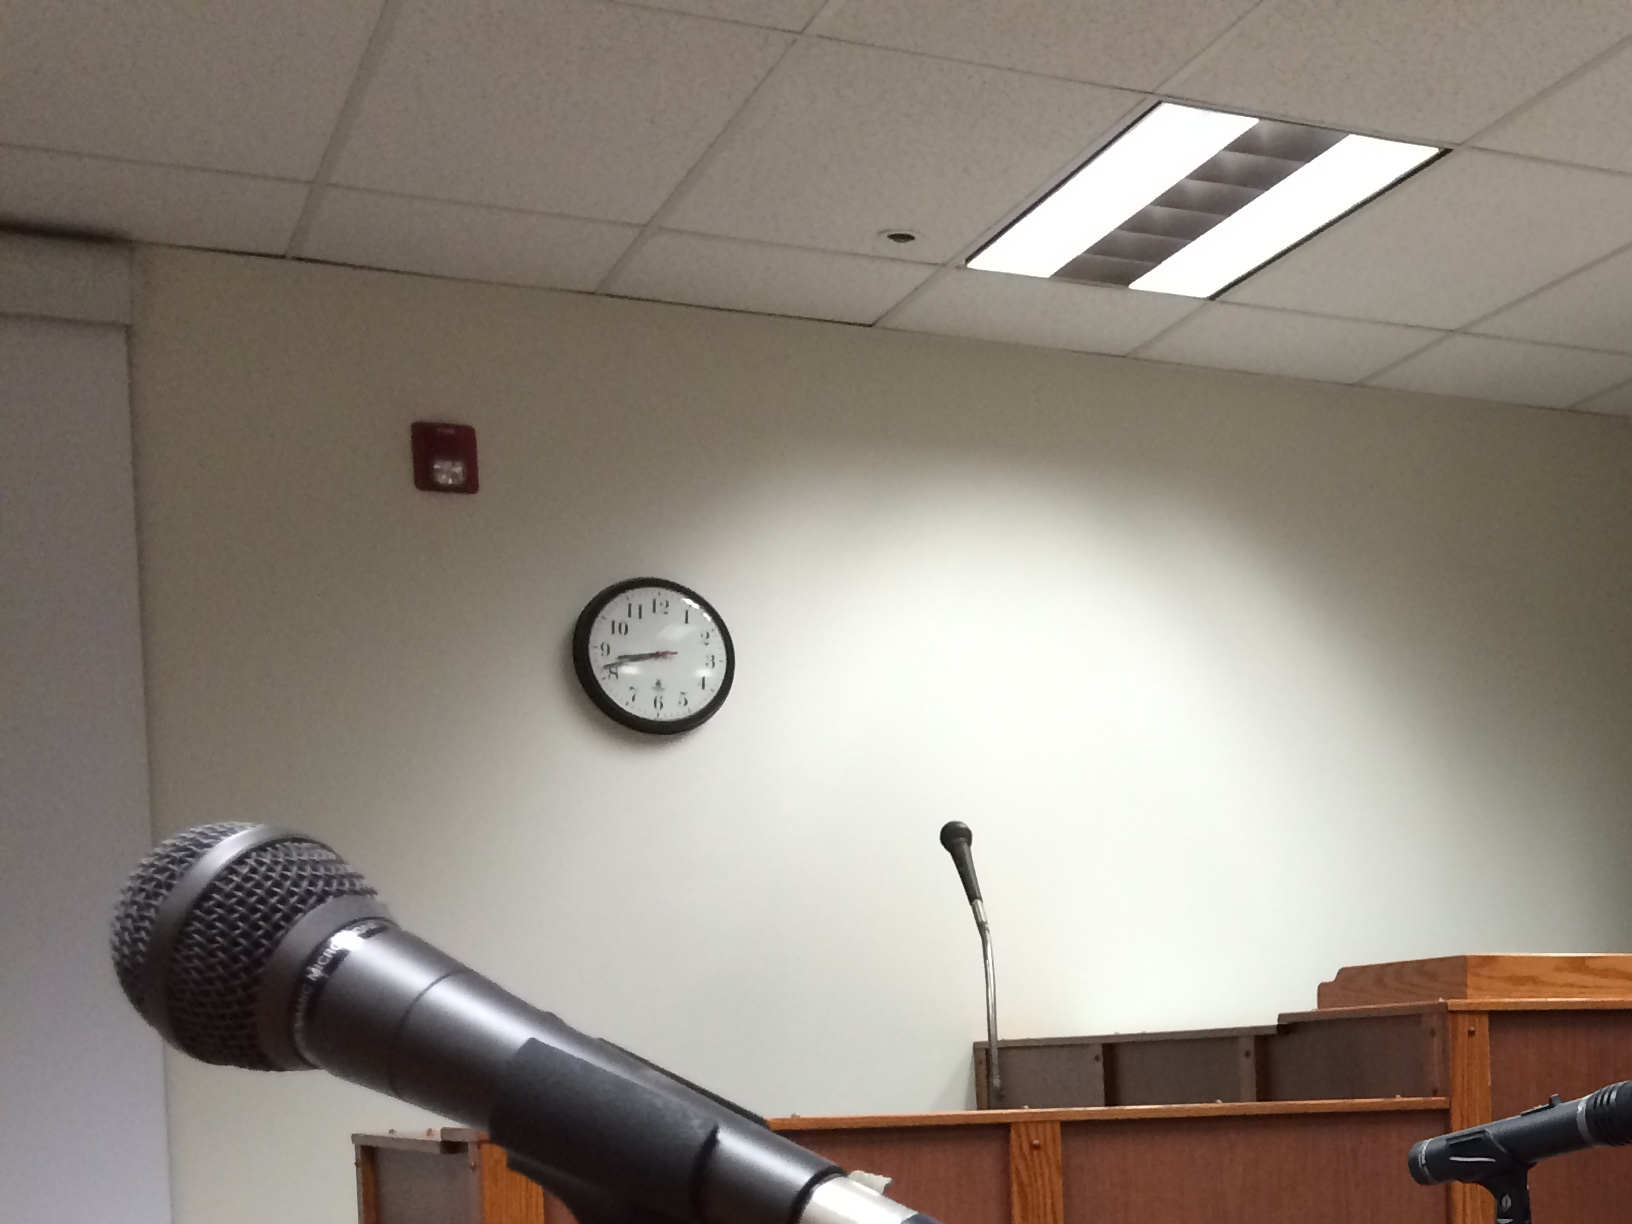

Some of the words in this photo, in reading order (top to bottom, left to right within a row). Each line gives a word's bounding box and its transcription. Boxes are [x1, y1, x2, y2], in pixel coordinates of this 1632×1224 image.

[627, 602, 643, 620] 11
[652, 598, 671, 614] 12
[610, 619, 630, 636] 10
[600, 641, 611, 657] 9
[653, 695, 664, 712] 6
